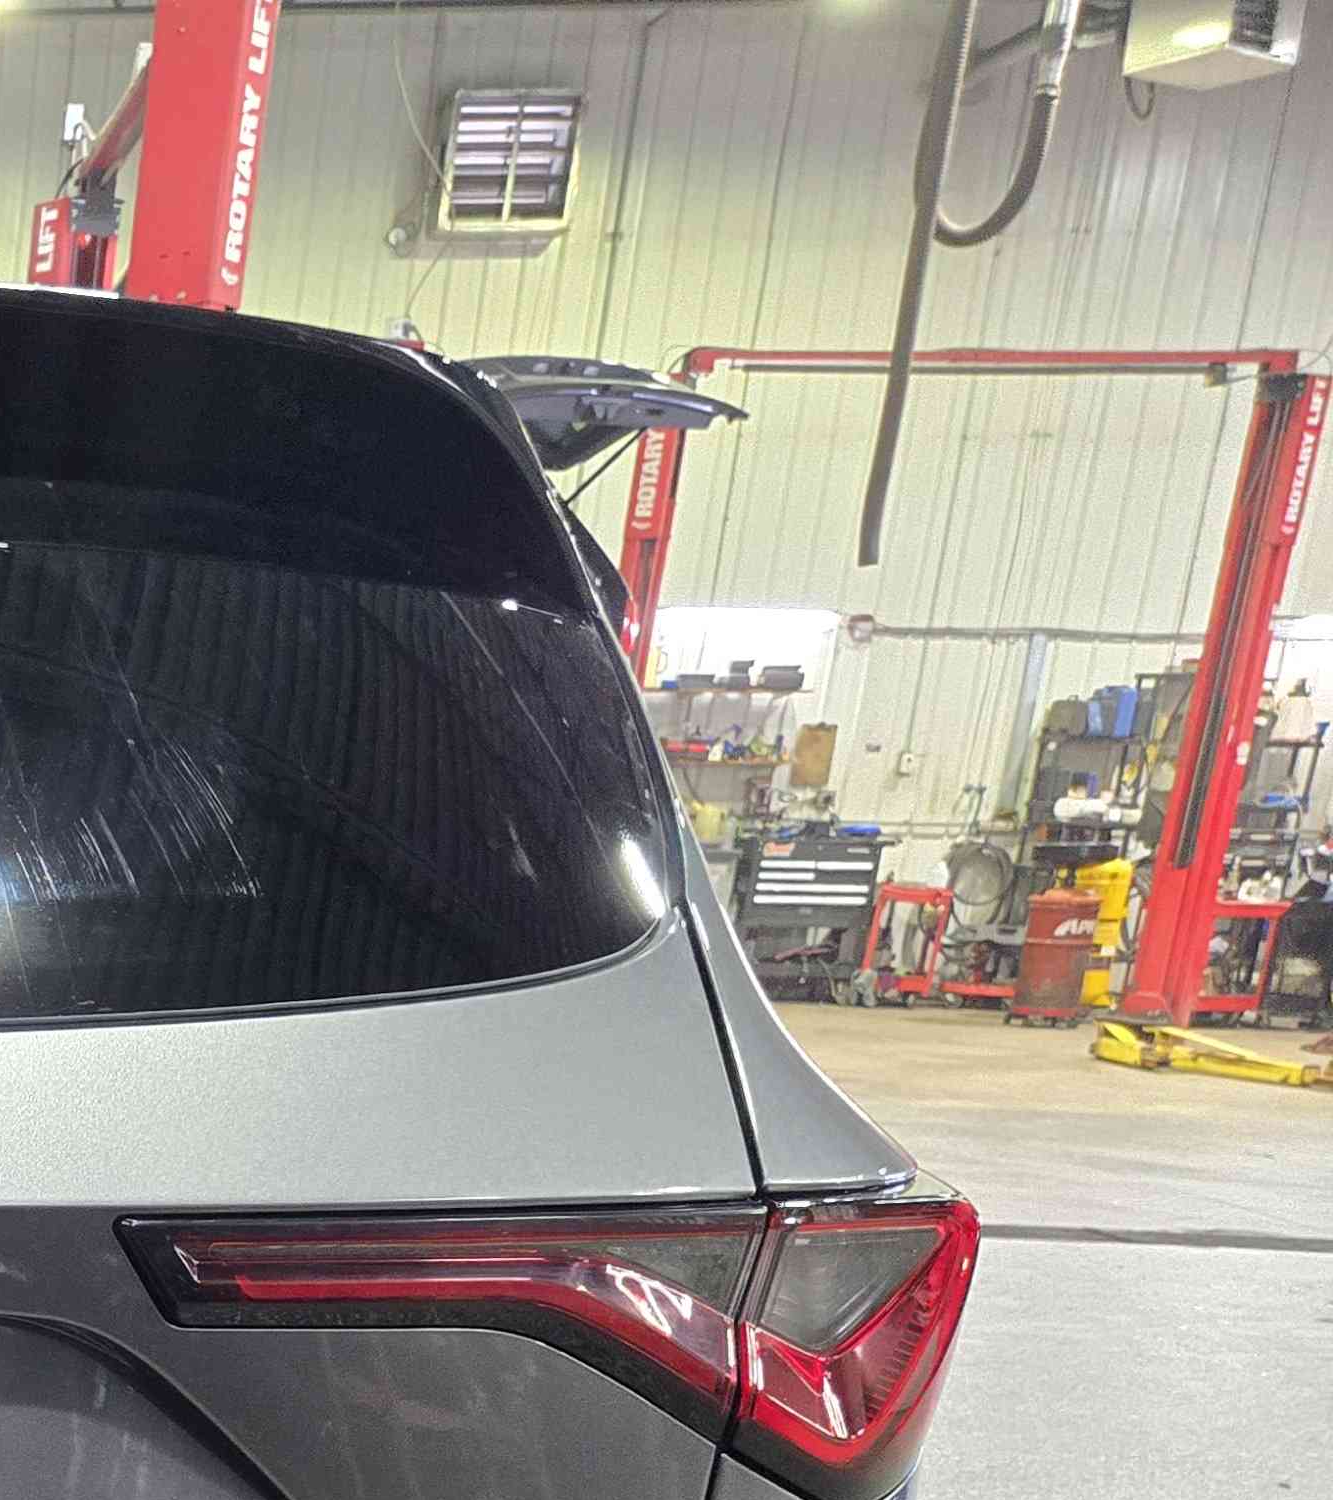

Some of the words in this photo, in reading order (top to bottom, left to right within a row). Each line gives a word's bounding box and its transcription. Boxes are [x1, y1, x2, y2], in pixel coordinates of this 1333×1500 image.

[224, 84, 261, 263] ROTARY
[248, 0, 274, 75] LIF
[35, 206, 58, 272] LIFT
[634, 429, 665, 517] ROTARY
[1284, 432, 1316, 523] ROTARY
